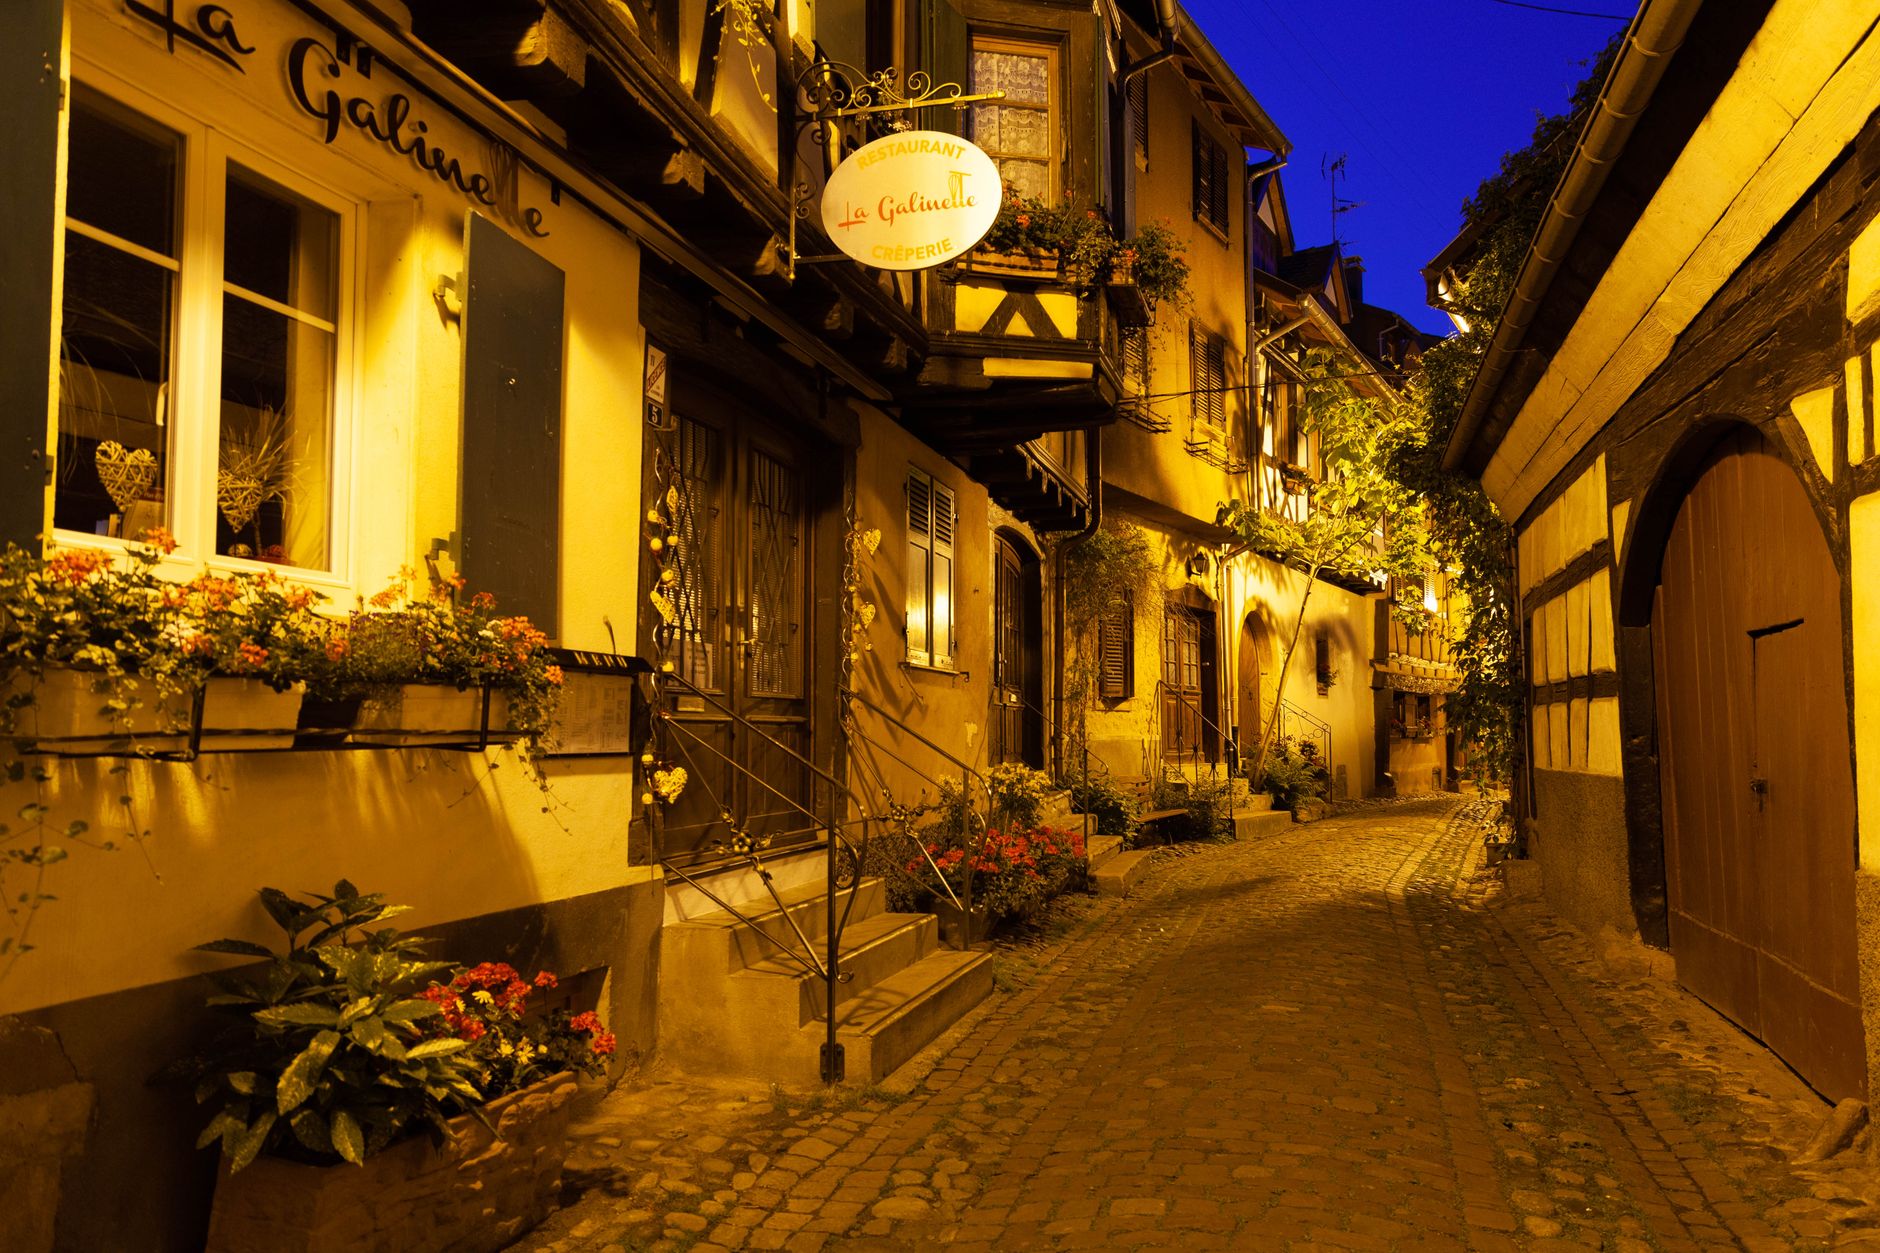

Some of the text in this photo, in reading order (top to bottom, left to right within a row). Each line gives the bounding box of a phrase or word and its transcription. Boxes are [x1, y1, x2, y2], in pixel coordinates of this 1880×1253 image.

[124, 0, 257, 75] La
[856, 139, 966, 171] RESTAURANT
[838, 170, 978, 232] La Galinette
[871, 238, 954, 262] CRÊPERIE
[651, 405, 659, 423] 5
[573, 651, 628, 668] MENU
